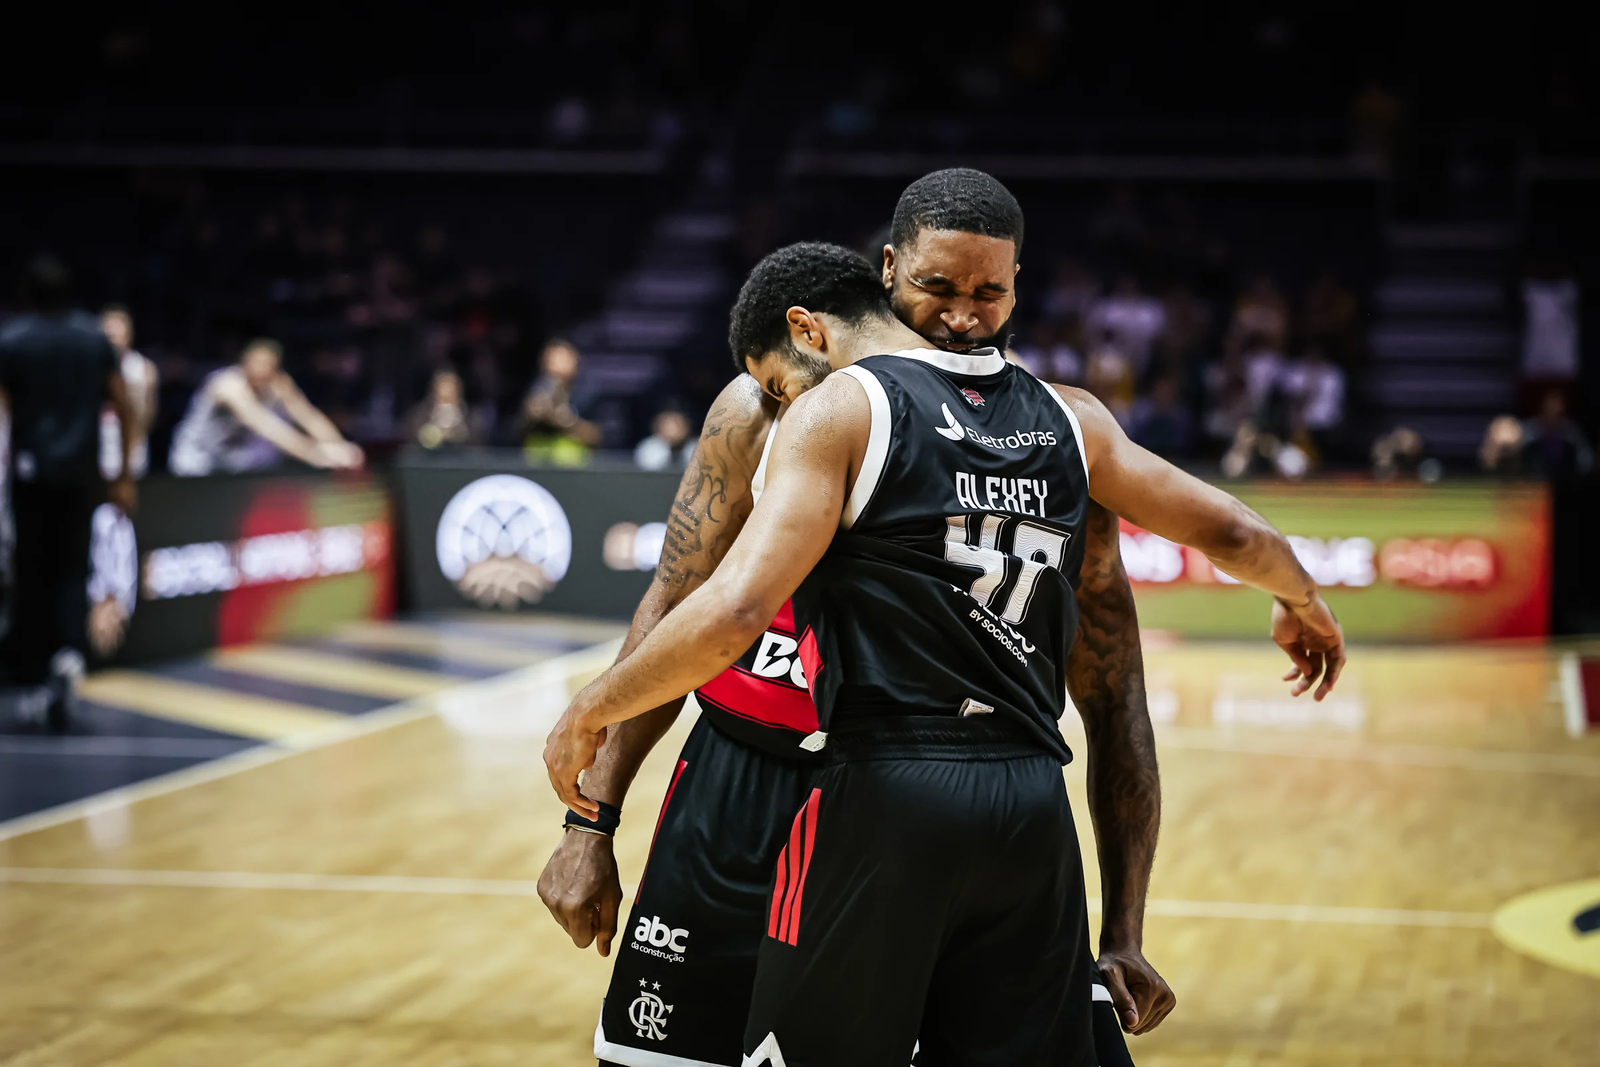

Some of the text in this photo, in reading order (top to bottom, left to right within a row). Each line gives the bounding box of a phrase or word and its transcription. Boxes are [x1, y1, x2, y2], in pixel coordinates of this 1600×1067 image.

[964, 426, 1057, 450] Eletrobras
[955, 471, 1048, 518] ALEXEY
[969, 608, 985, 622] BY
[980, 618, 1029, 668] SOCIOS.COM
[630, 941, 685, 963] da construção
[634, 915, 690, 953] abc
